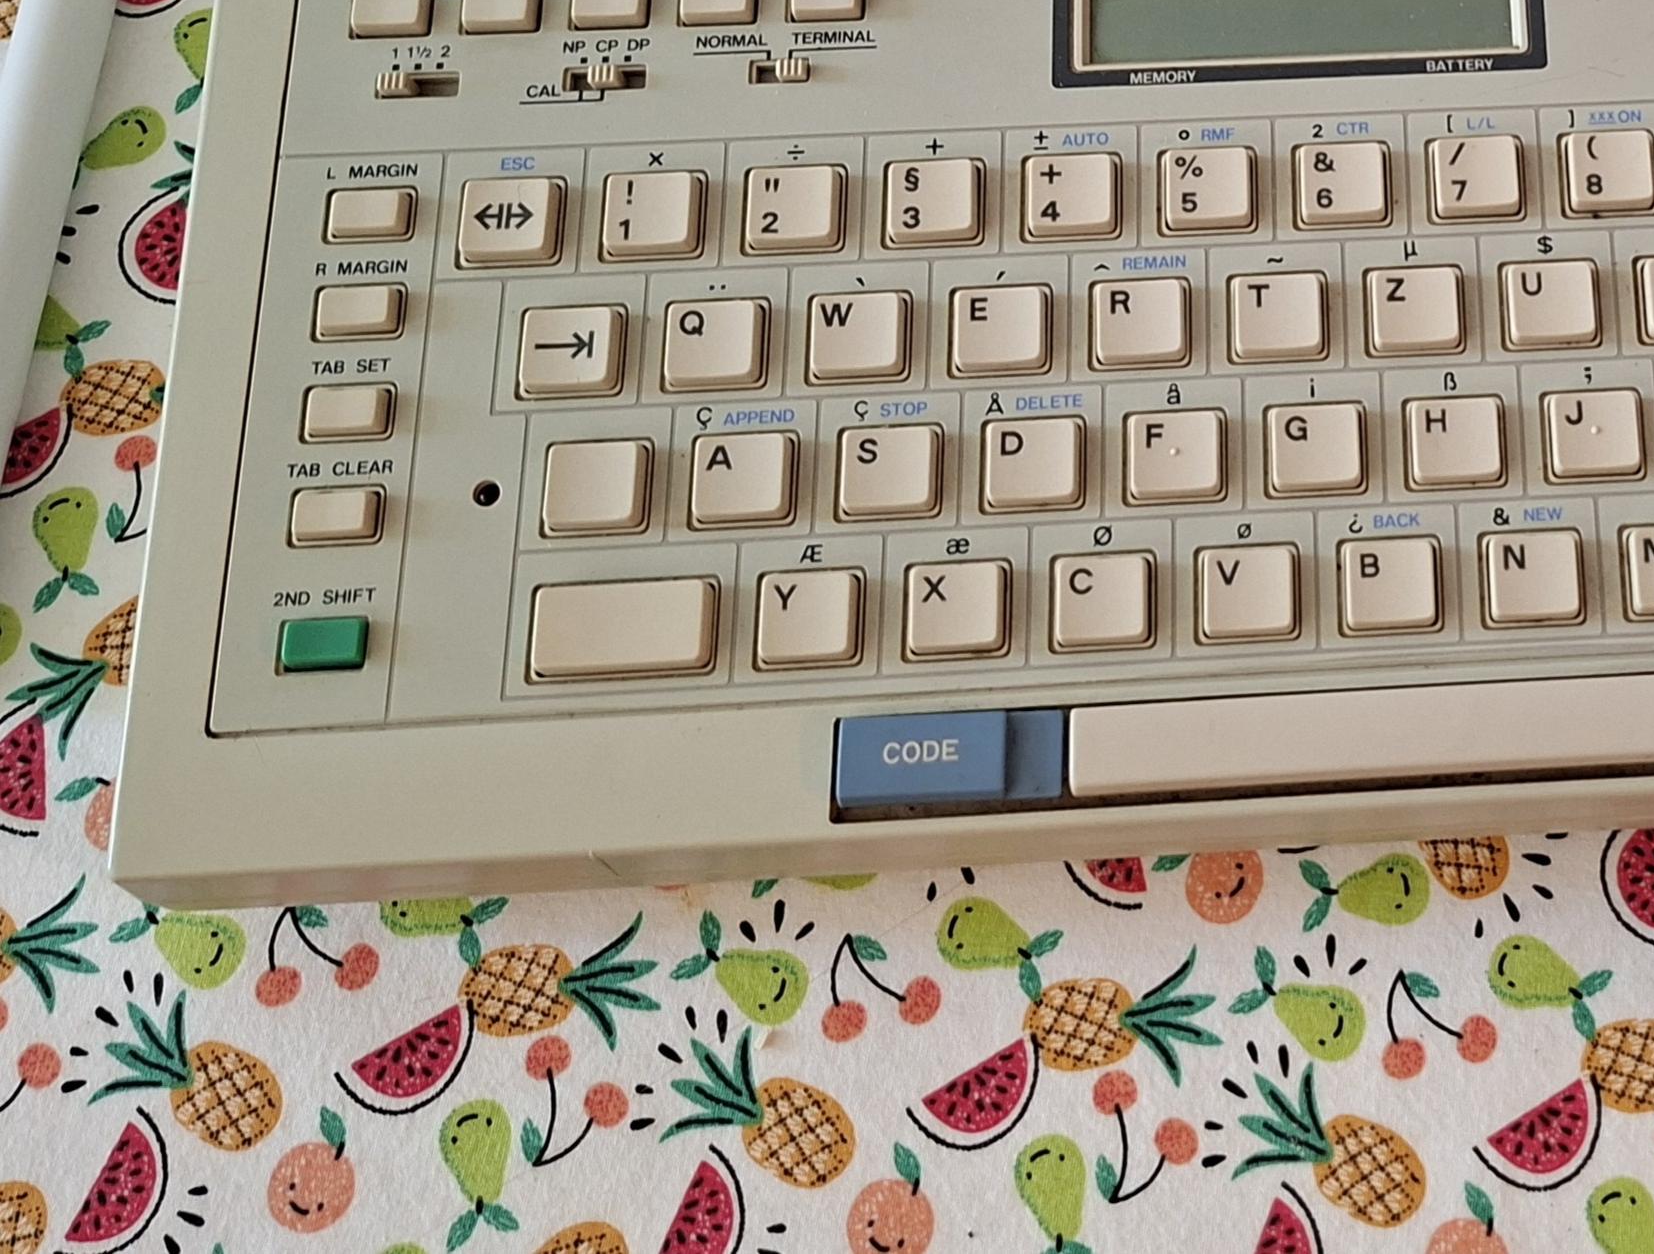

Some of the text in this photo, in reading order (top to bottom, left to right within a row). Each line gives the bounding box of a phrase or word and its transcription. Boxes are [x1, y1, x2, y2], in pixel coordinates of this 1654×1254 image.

[563, 37, 651, 55] NP CP DP
[695, 33, 769, 50] NORMAL
[791, 29, 876, 45] TERMINAL
[440, 45, 451, 59] 2
[1425, 59, 1494, 73] BATTERY
[1129, 71, 1197, 85] MEMORY
[526, 85, 561, 100] CAL
[1337, 122, 1370, 136] CTR
[1467, 117, 1496, 131] L/L
[1062, 132, 1109, 147] AUTO
[1201, 128, 1235, 142] RMF
[326, 164, 418, 180] L MARGIN
[500, 156, 536, 171] ESC
[1174, 155, 1204, 179] %
[1313, 152, 1336, 172] &
[904, 167, 919, 192] §
[1586, 174, 1602, 195] 8
[1316, 188, 1332, 209] 6
[1452, 179, 1467, 202] 7
[1040, 201, 1061, 222] 4
[1181, 192, 1198, 213] 5
[761, 212, 780, 234] 2
[902, 207, 920, 229] 3
[619, 219, 630, 241] 1
[1537, 236, 1553, 255] $
[315, 260, 409, 276] R MARGIN
[1122, 255, 1186, 271] REMAIN
[1386, 278, 1406, 302] Z
[1521, 273, 1543, 297] U
[1110, 290, 1132, 315] R
[1248, 284, 1270, 308] T
[820, 302, 854, 327] W
[969, 297, 989, 322] E
[679, 310, 705, 337] Q
[312, 358, 391, 375] TAB SET
[986, 392, 1083, 415] Å DELETE
[1167, 383, 1181, 405] å
[723, 409, 795, 426] APPEND
[880, 402, 927, 417] STOP
[1565, 400, 1584, 425] J
[1285, 416, 1308, 442] G
[1425, 409, 1448, 433] H
[1000, 431, 1023, 456] D
[1146, 424, 1164, 449] F
[707, 445, 733, 471] A
[857, 438, 878, 464] S
[287, 459, 394, 478] TAB CLEAR
[1373, 514, 1420, 529] BACK
[1492, 507, 1562, 525] & NEW
[800, 545, 823, 563] Æ
[946, 536, 969, 555] æ
[1360, 554, 1380, 577] B
[1503, 545, 1526, 570] N
[1069, 568, 1093, 595] C
[1217, 560, 1240, 585] V
[274, 587, 376, 608] 2ND SHIFT
[774, 585, 796, 611] Y
[922, 576, 946, 603] X
[883, 739, 960, 764] CODE
